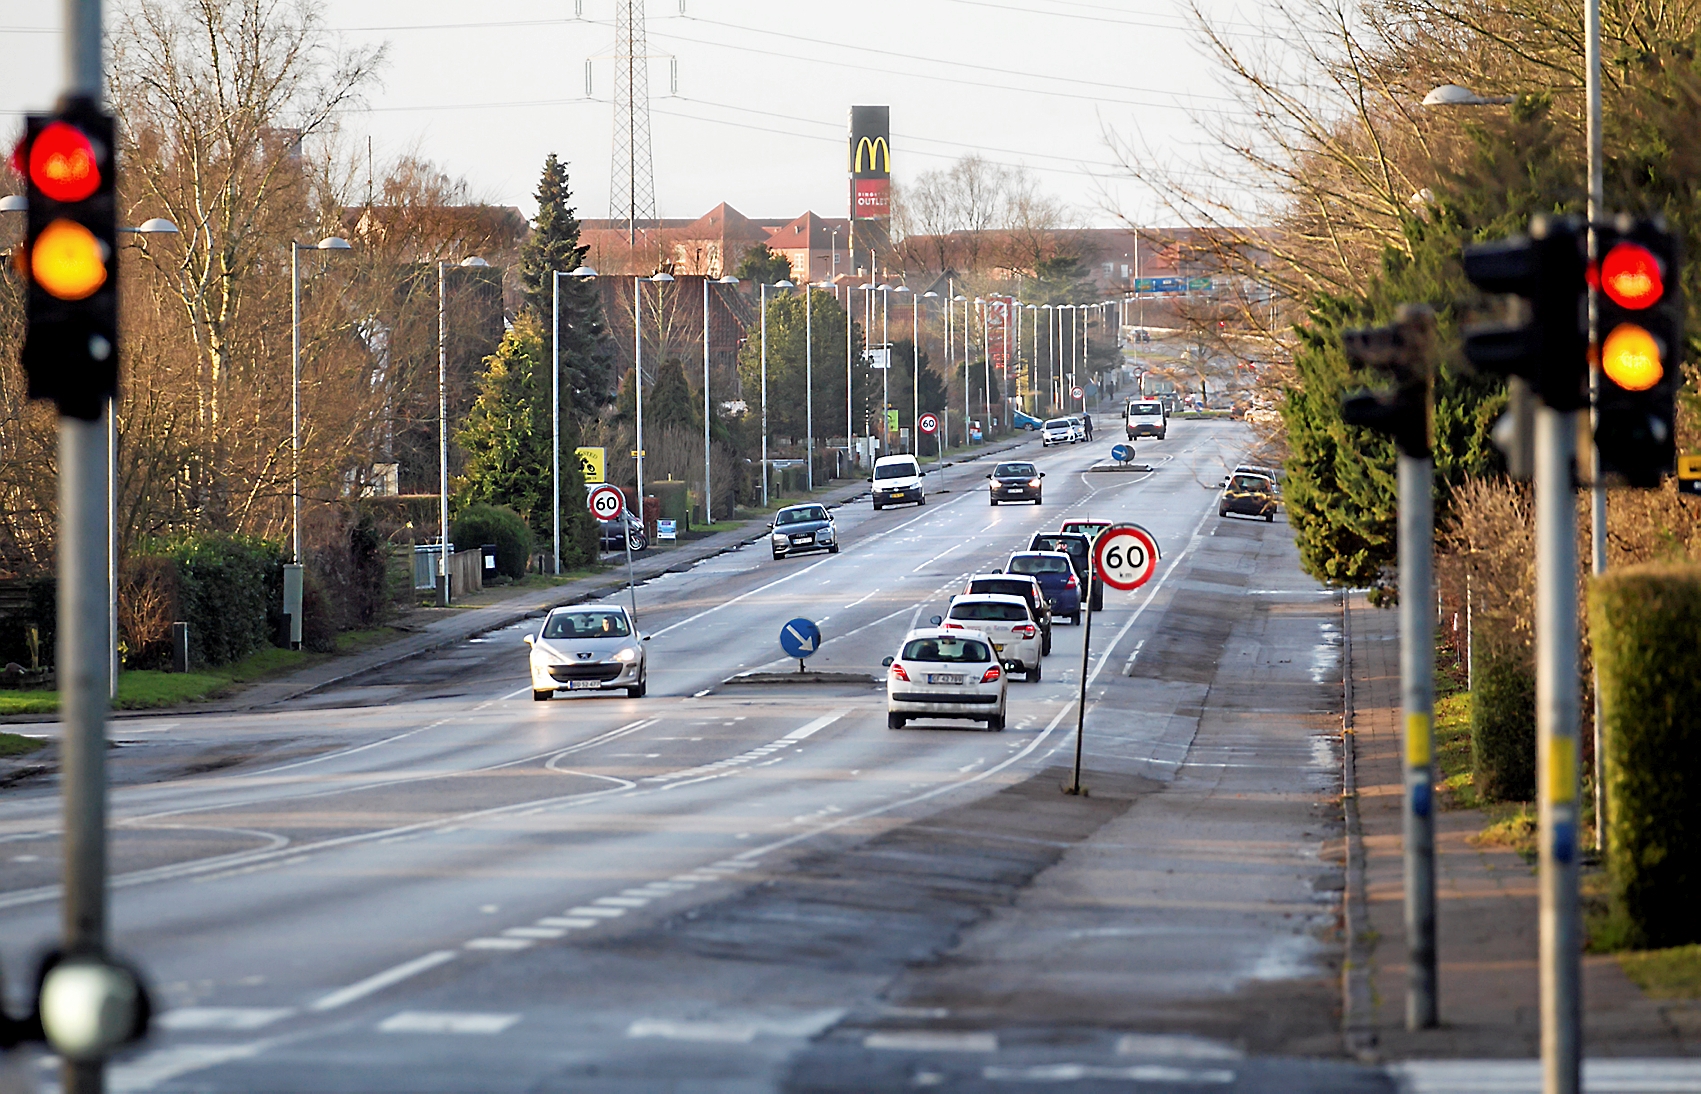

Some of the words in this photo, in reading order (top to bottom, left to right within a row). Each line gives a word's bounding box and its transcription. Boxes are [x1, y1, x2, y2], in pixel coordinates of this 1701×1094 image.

[858, 197, 889, 206] OUTLET
[922, 419, 935, 428] 60
[596, 496, 617, 511] 60
[1106, 545, 1144, 569] 60
